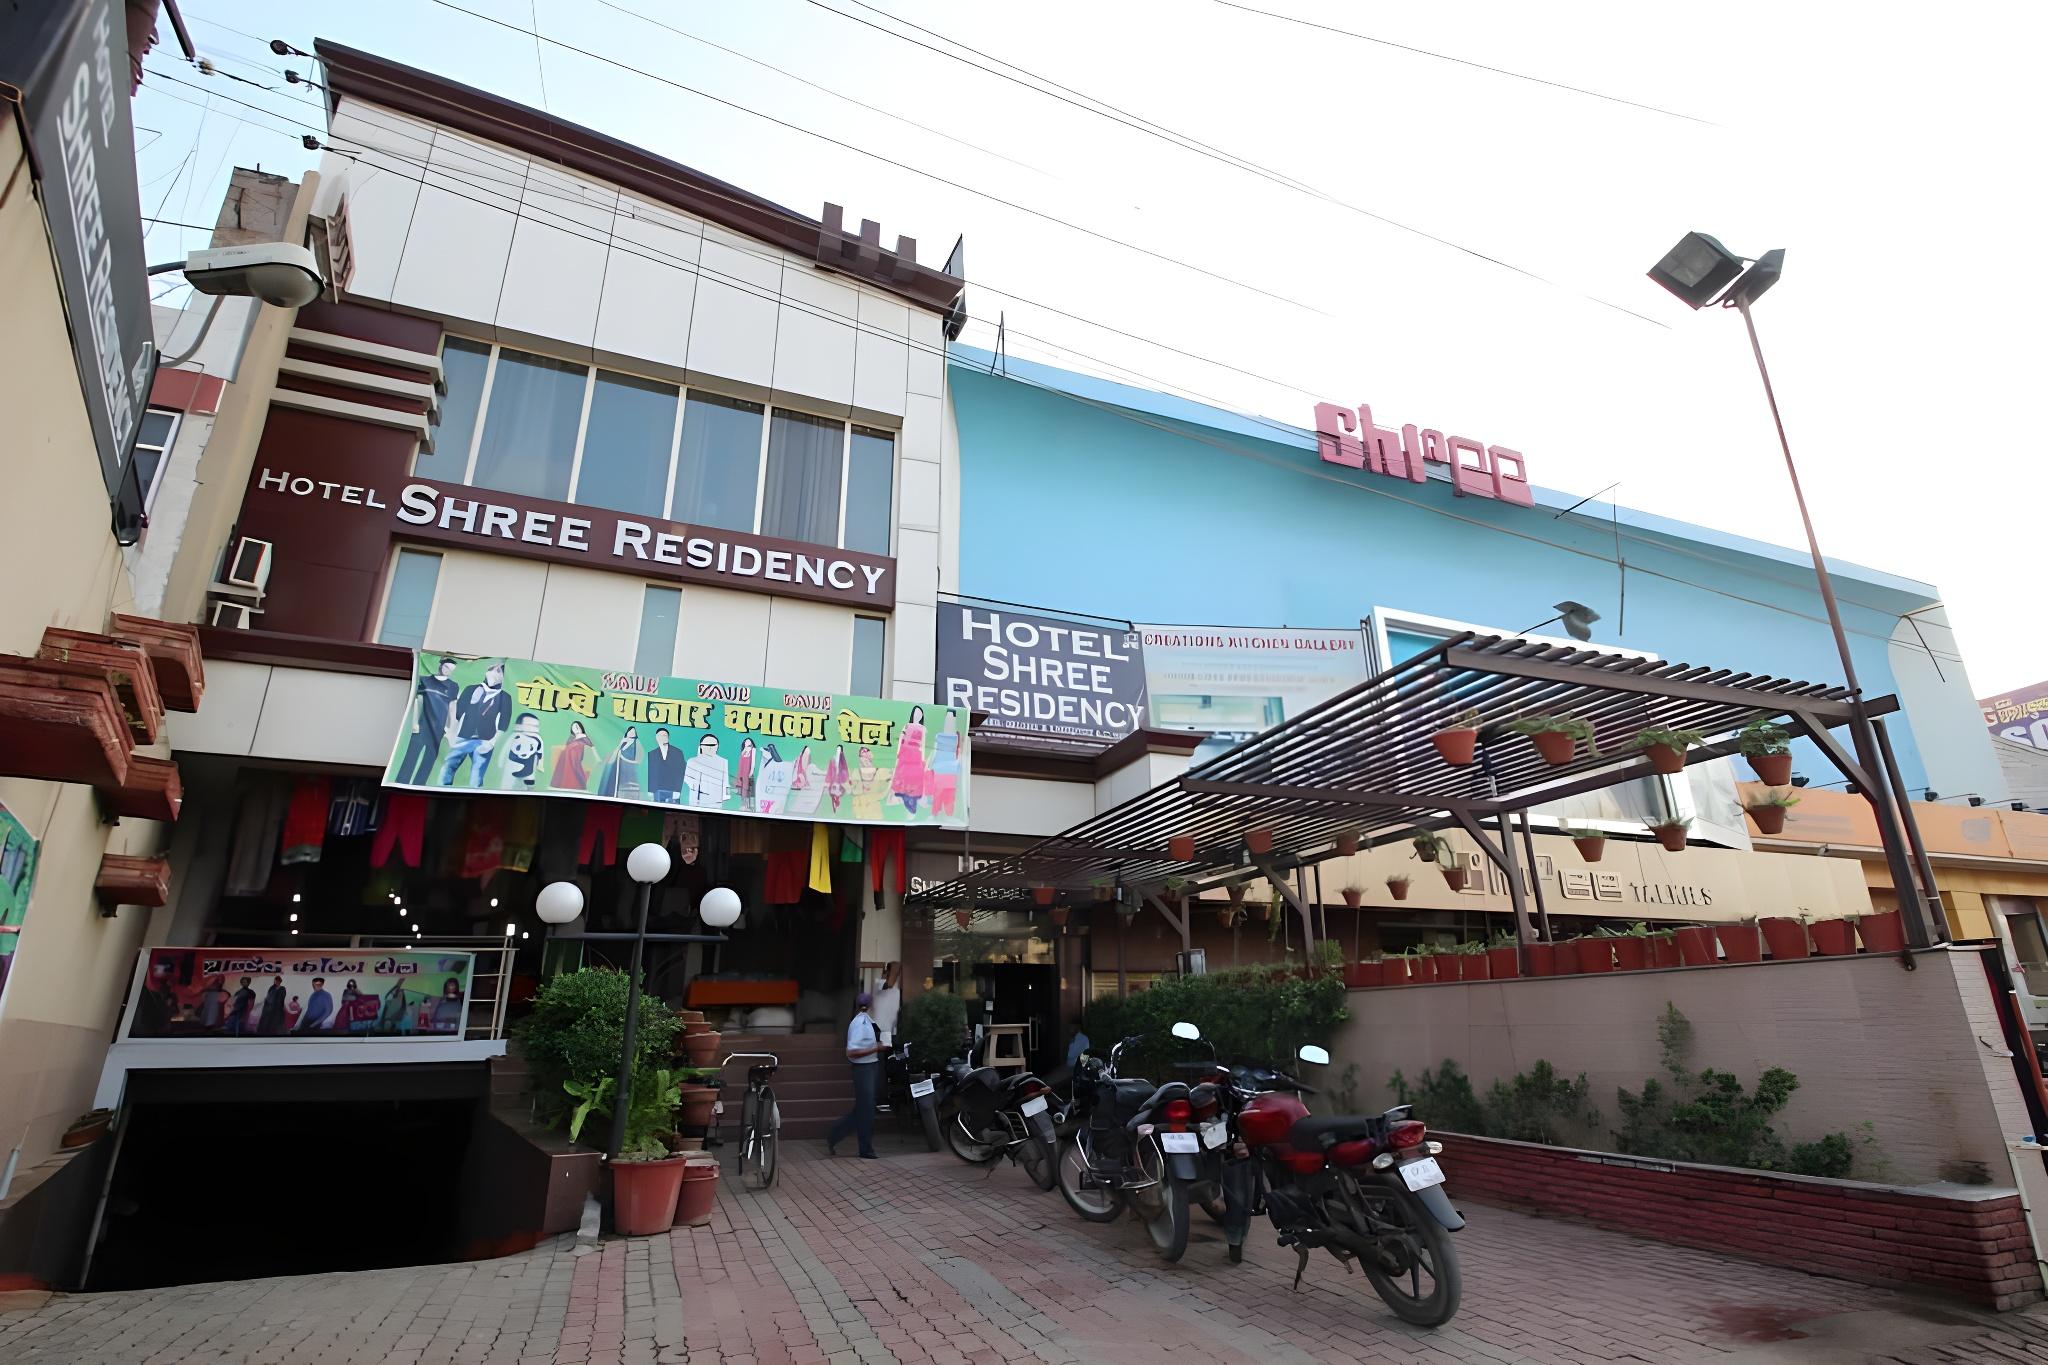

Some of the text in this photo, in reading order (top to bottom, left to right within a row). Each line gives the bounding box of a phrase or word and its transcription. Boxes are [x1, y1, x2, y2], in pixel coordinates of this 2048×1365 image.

[258, 468, 887, 595] HOTEL SHREE RESIDENCY
[962, 609, 1130, 662] HOTEL
[983, 644, 1114, 695] SHREE
[836, 708, 895, 746] सेल
[946, 676, 1145, 730] RESIDENCY
